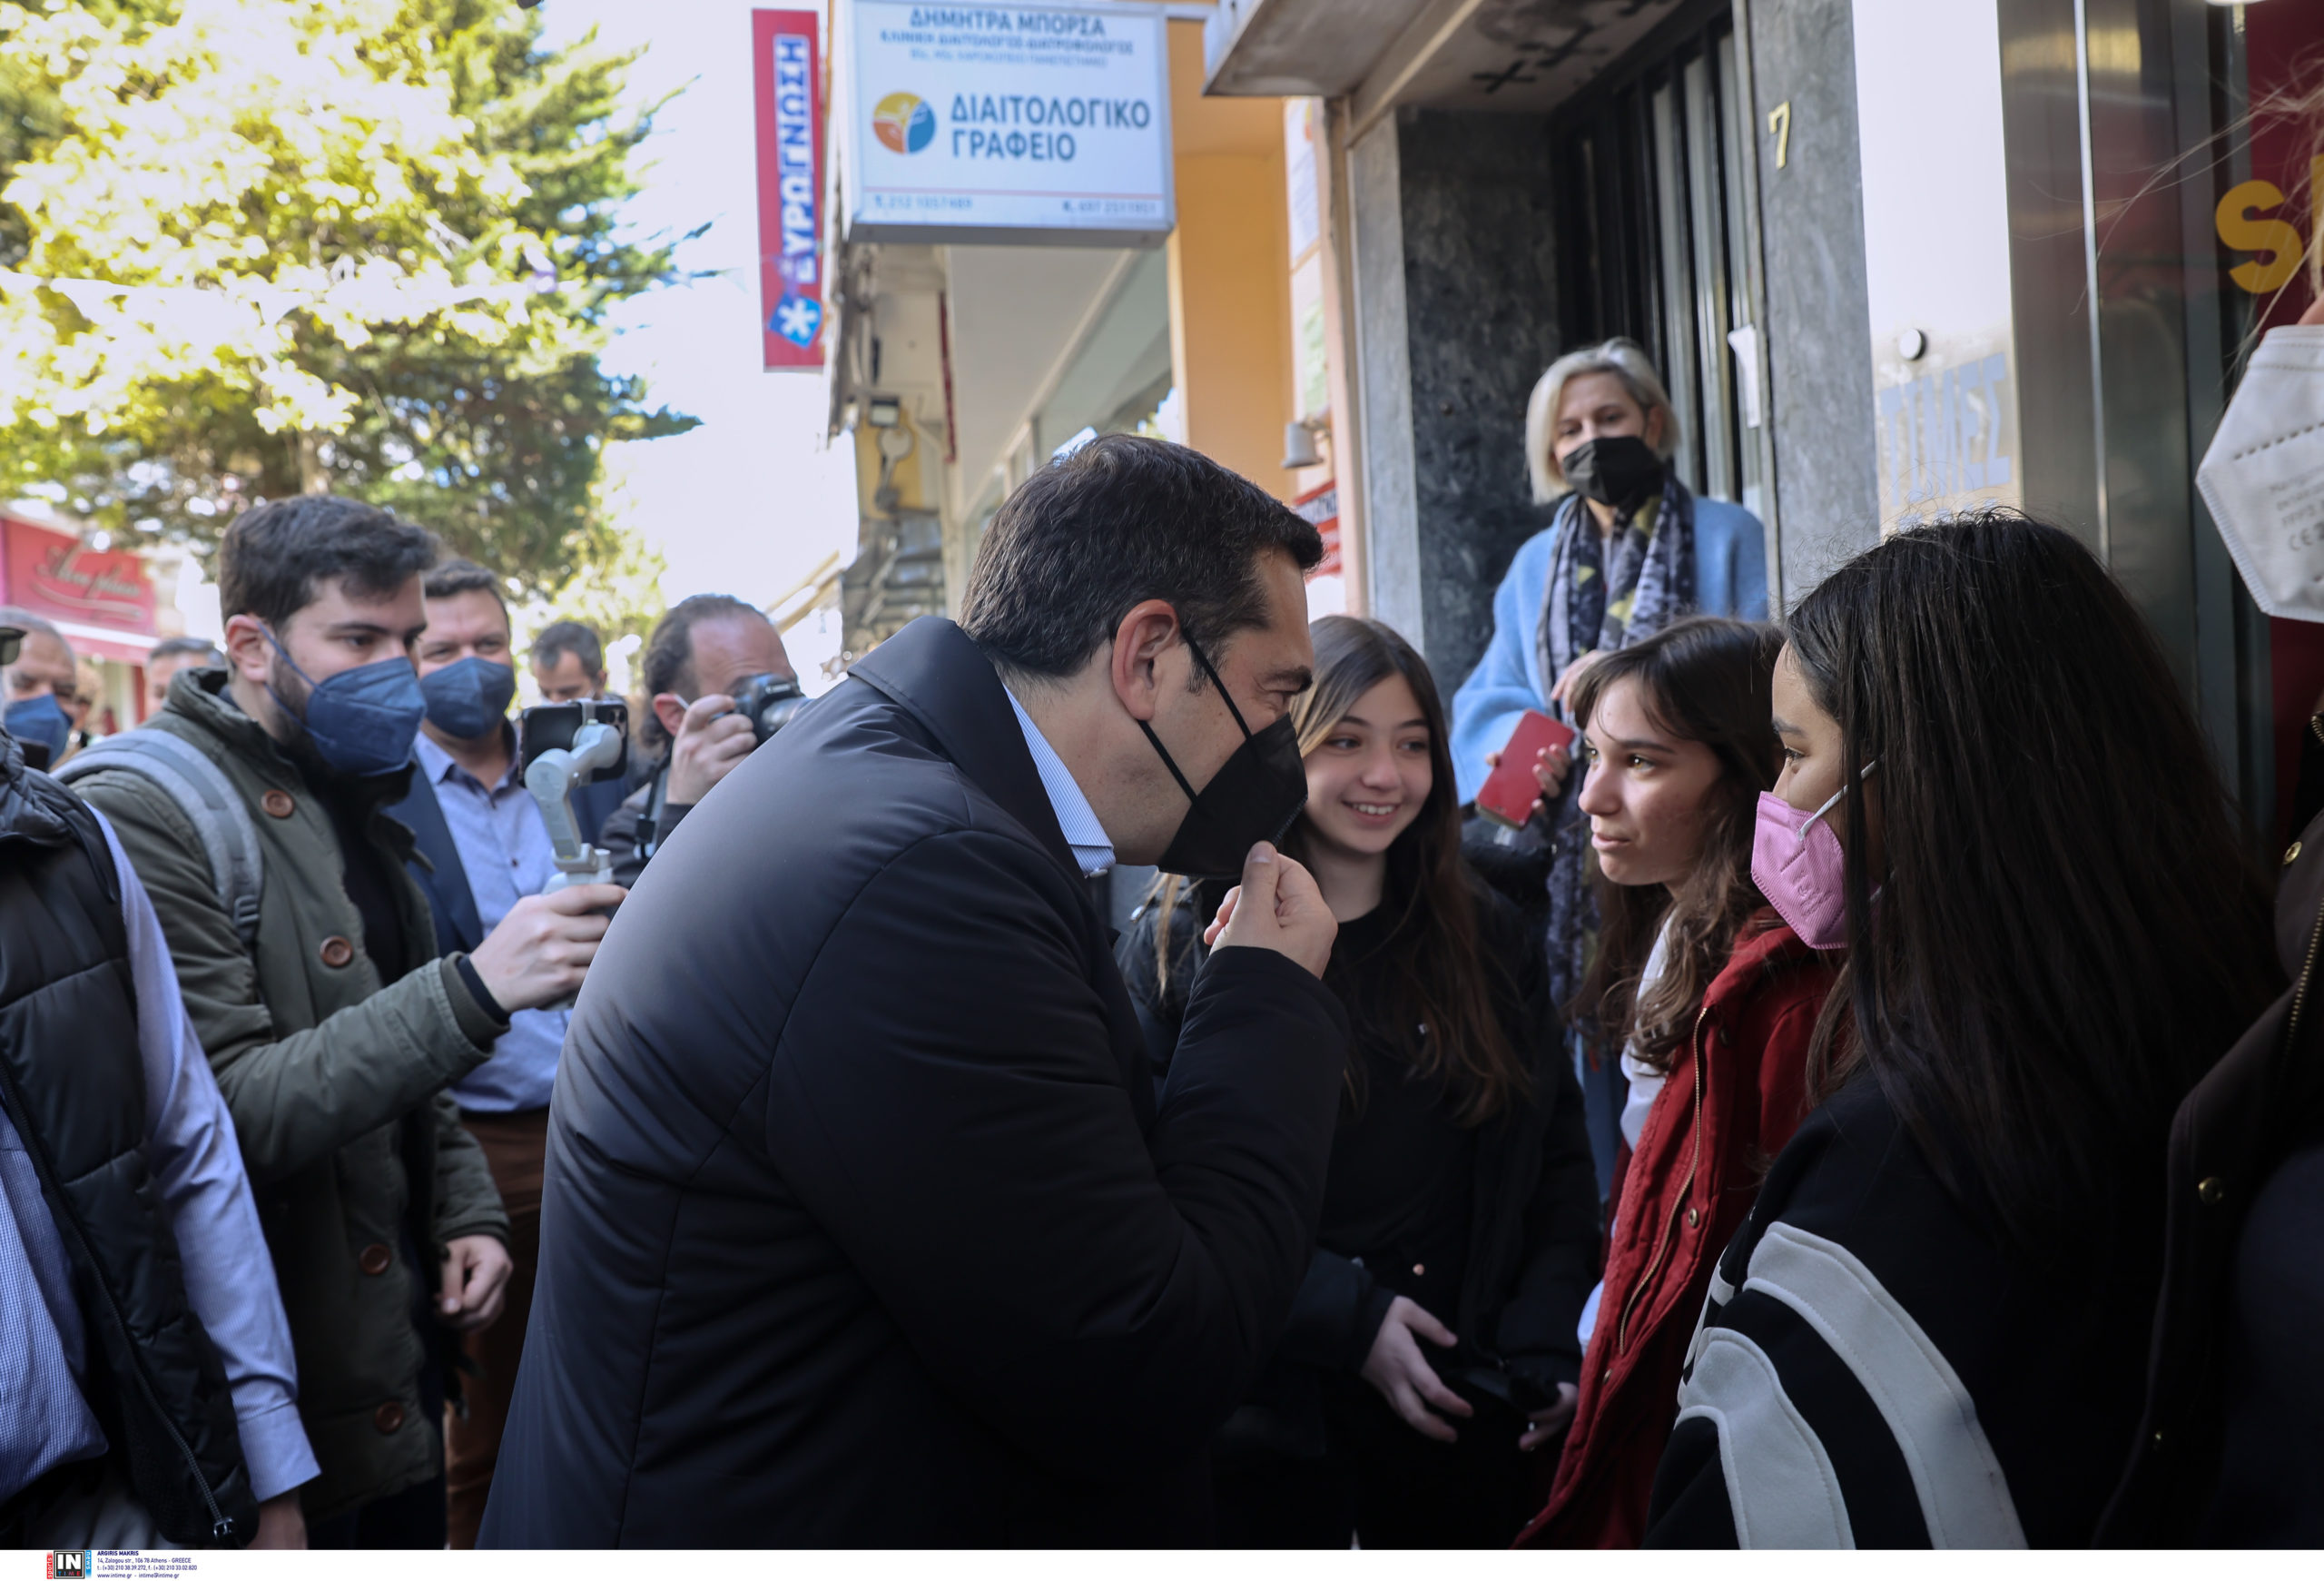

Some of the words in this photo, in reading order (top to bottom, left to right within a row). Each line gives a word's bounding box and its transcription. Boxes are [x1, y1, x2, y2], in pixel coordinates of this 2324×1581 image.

[910, 7, 1012, 32] ΔΗΜΗΤΡΑ
[1017, 13, 1106, 36] ΜΠΟΡΣΑ
[950, 94, 1151, 129] ΔΙΑΙΤΟΛΟΓΙΚΟ
[951, 130, 1077, 162] ΓΡΑΦΕΙΟ
[1769, 102, 1790, 169] 7
